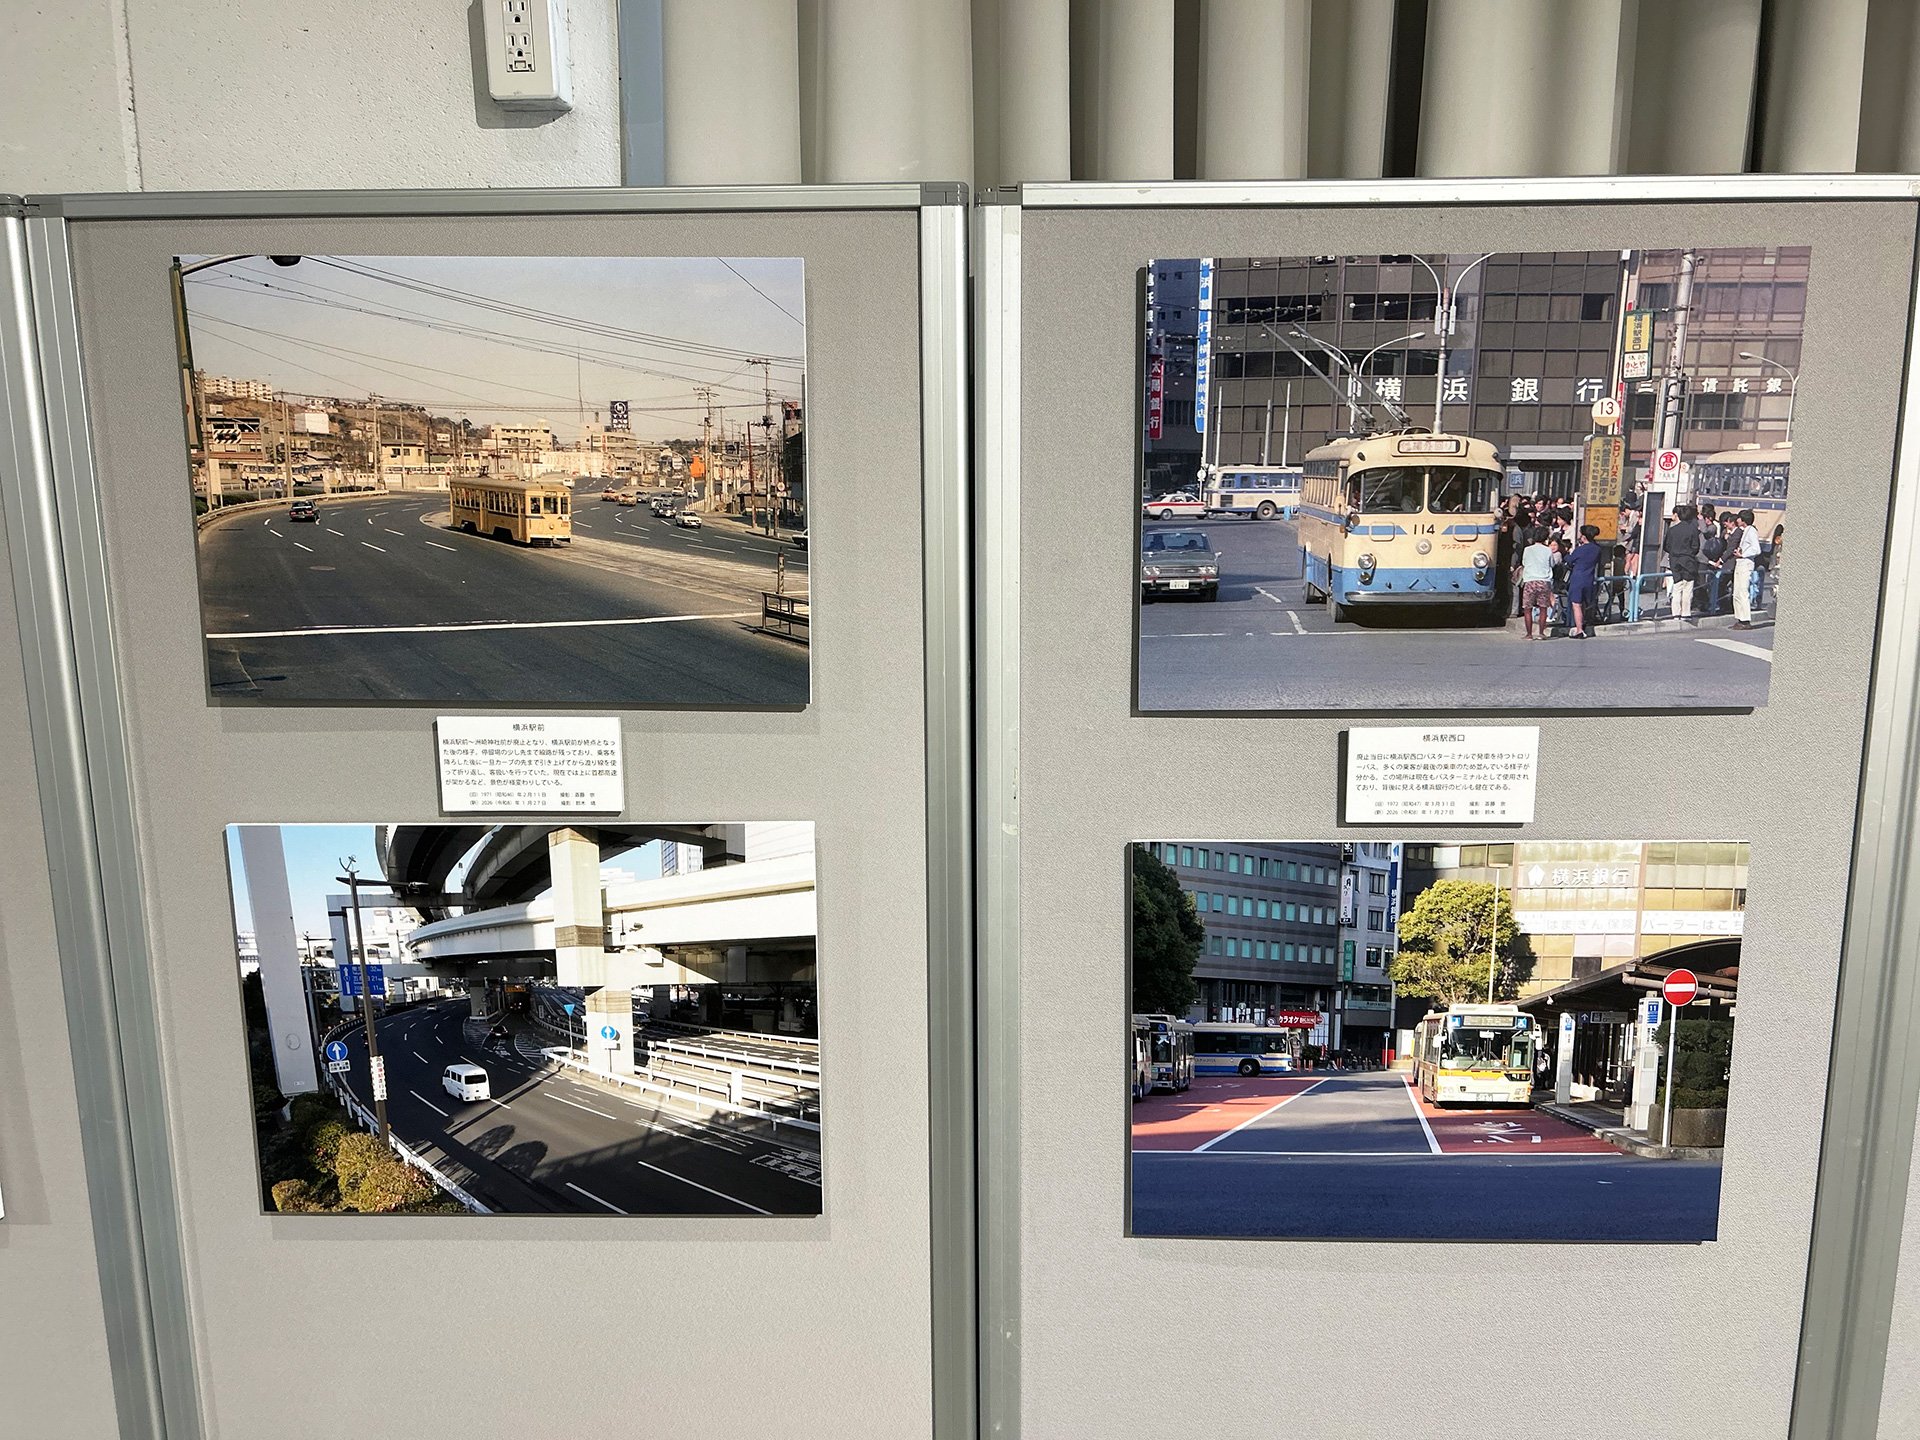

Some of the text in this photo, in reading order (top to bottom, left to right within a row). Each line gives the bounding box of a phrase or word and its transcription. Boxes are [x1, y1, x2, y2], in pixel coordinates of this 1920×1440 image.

[1150, 361, 1161, 429] 太陽銀行
[1375, 376, 1604, 403] 横浜銀行
[1600, 401, 1614, 415] 13
[1413, 524, 1436, 534] 114
[512, 723, 545, 731] 横浜駅前
[1422, 734, 1465, 742] 横浜駅西口
[1552, 867, 1630, 886] 横浜銀行
